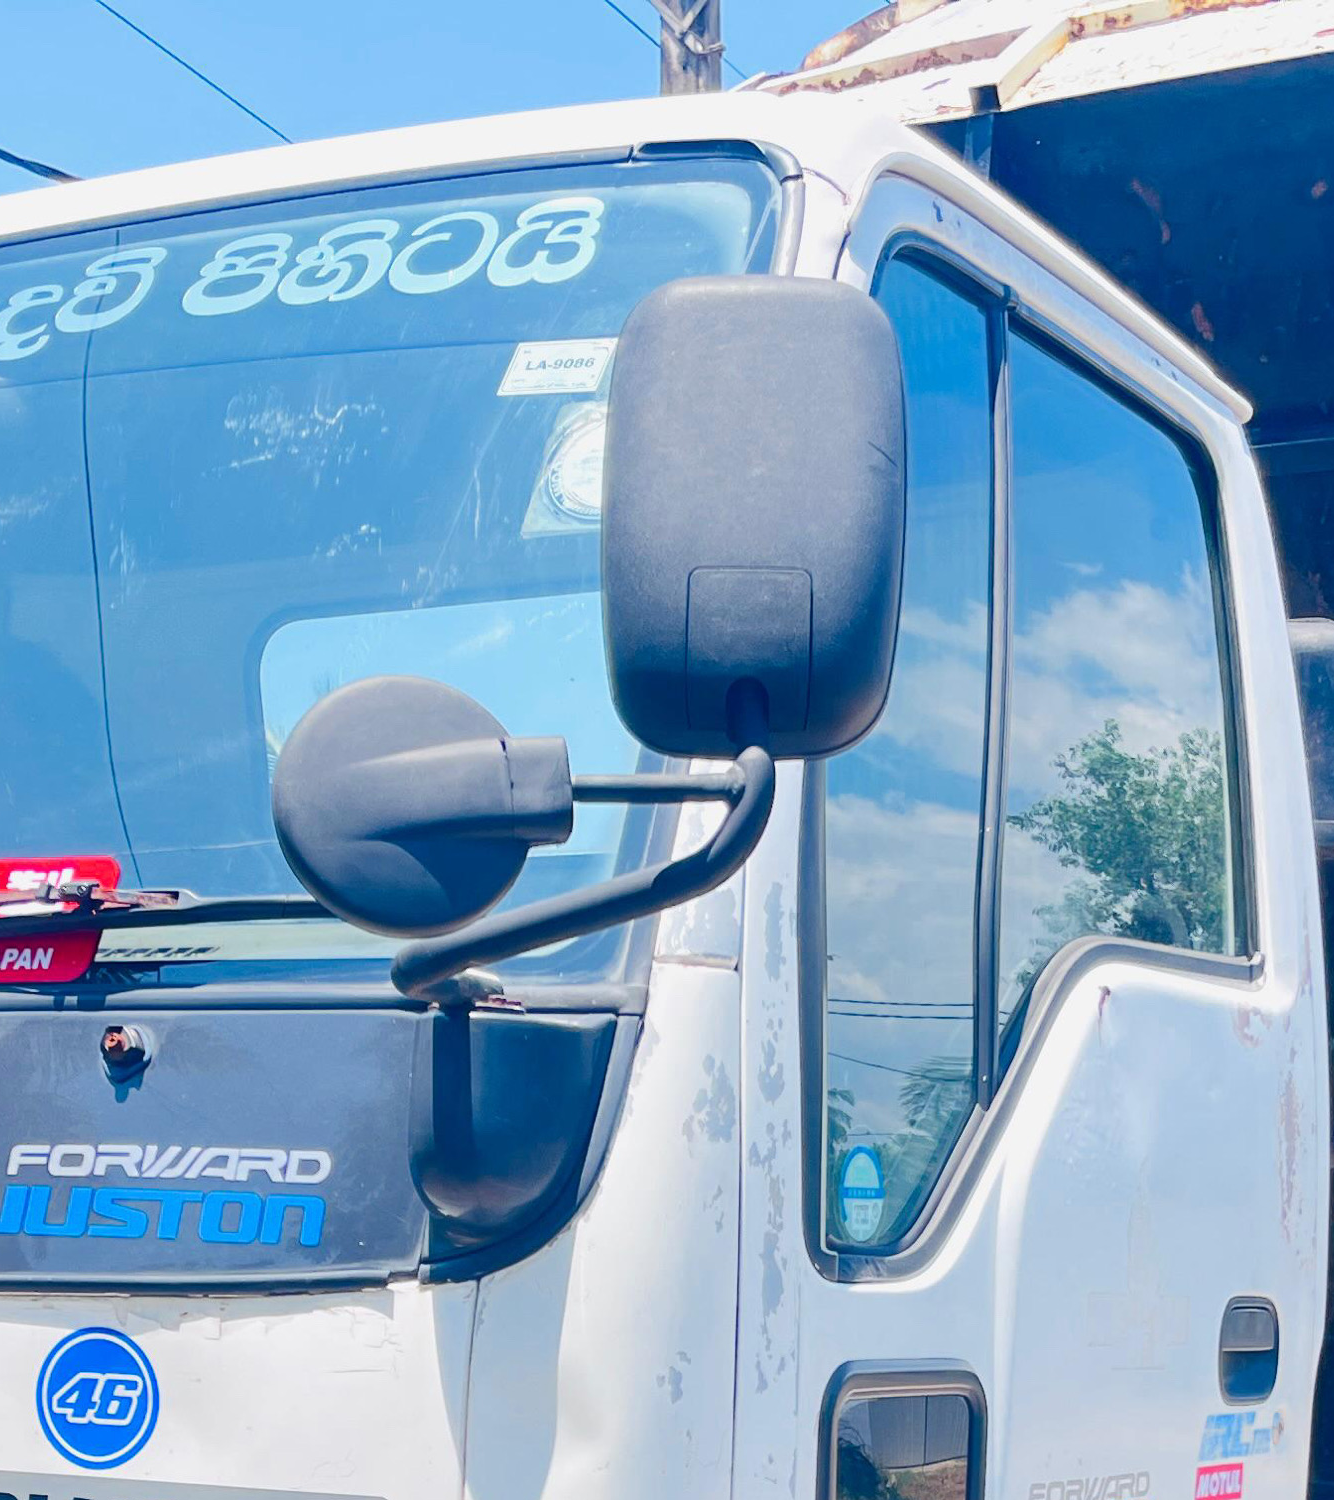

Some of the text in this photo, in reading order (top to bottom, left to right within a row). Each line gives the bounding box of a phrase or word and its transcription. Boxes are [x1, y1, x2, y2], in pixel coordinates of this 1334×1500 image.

[182, 196, 605, 317] පිහිටයි
[525, 357, 596, 371] LA-9086
[6, 1143, 333, 1185] FORWARD
[51, 1371, 145, 1426] 46
[1196, 1468, 1242, 1499] MOTUL
